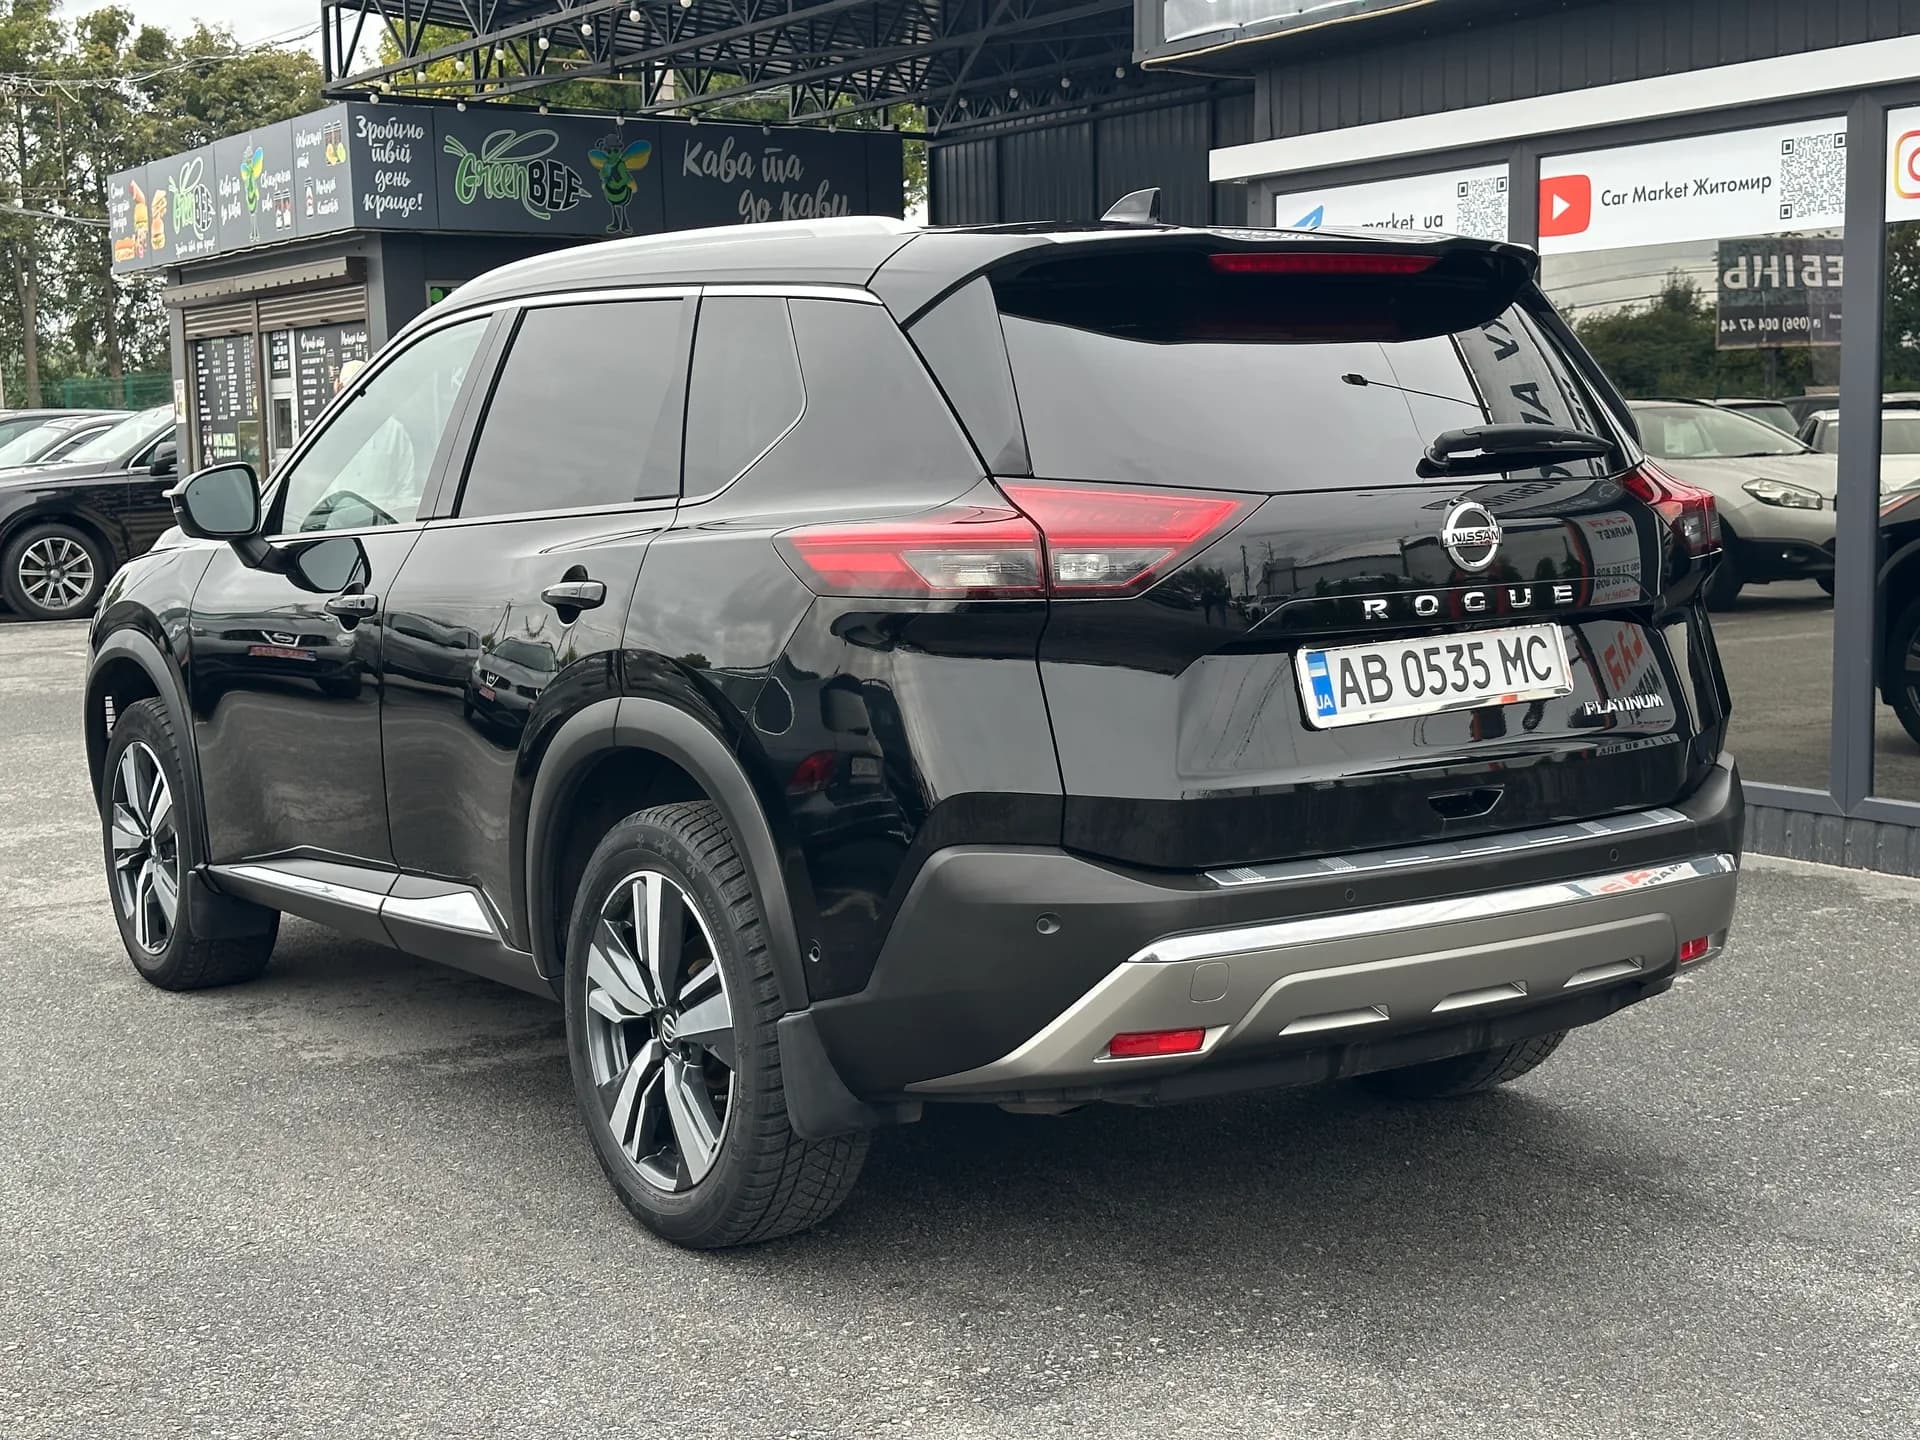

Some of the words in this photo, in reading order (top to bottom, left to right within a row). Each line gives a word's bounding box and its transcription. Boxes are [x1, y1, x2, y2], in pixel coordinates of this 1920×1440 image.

[355, 115, 425, 146] Зробимо
[371, 142, 412, 164] твій
[683, 136, 755, 183] Кава
[374, 169, 412, 193] день
[1600, 188, 1628, 207] Car
[1632, 180, 1690, 205] Market
[1692, 174, 1773, 198] Житомир
[363, 193, 423, 219] краще!
[738, 189, 773, 224] до
[779, 179, 851, 221] кави
[1361, 211, 1415, 230] rket
[1452, 530, 1499, 543] NISSAN
[1362, 585, 1573, 620] ROGUE
[1339, 654, 1394, 708] AB
[1400, 641, 1491, 698] 0535
[1500, 635, 1553, 687] MC
[1316, 695, 1335, 710] UA
[1583, 693, 1665, 716] PLATINUM
